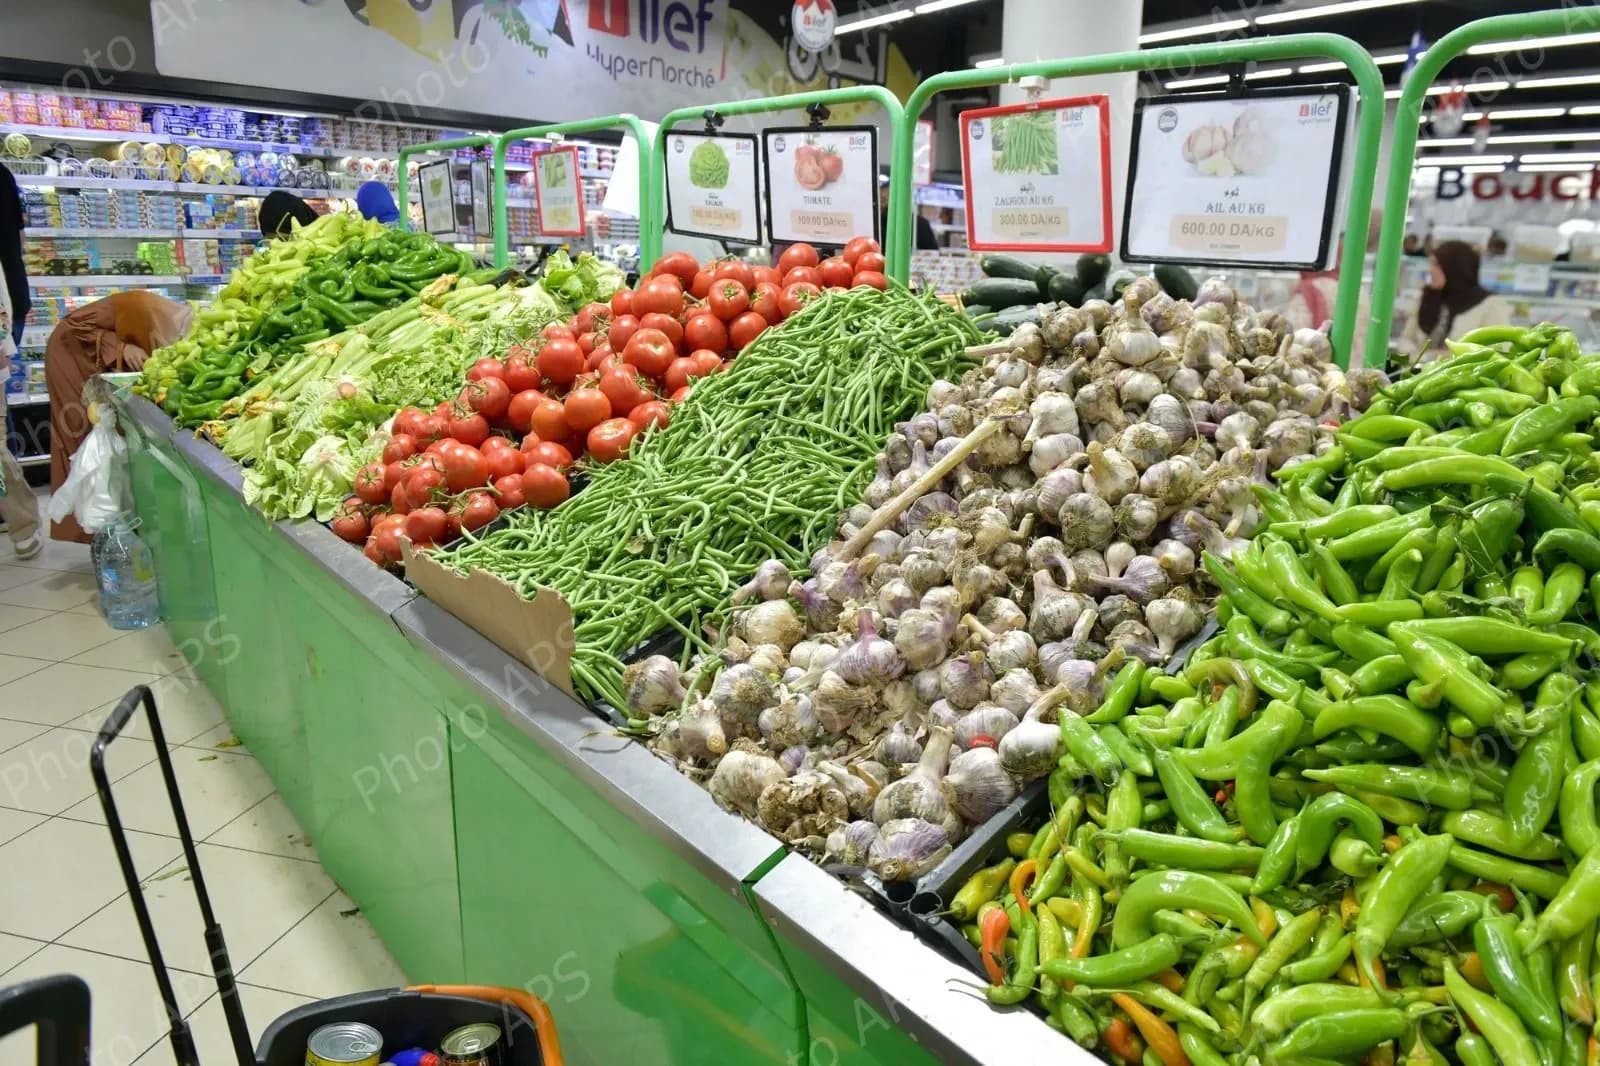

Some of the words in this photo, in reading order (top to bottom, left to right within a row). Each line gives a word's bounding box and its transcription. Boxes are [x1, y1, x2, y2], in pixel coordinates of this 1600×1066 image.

[1204, 202, 1225, 214] AIL
[1228, 203, 1246, 215] AU
[1248, 203, 1265, 215] KG
[1181, 221, 1226, 236] 600.00
[1230, 222, 1275, 238] DA/KG
